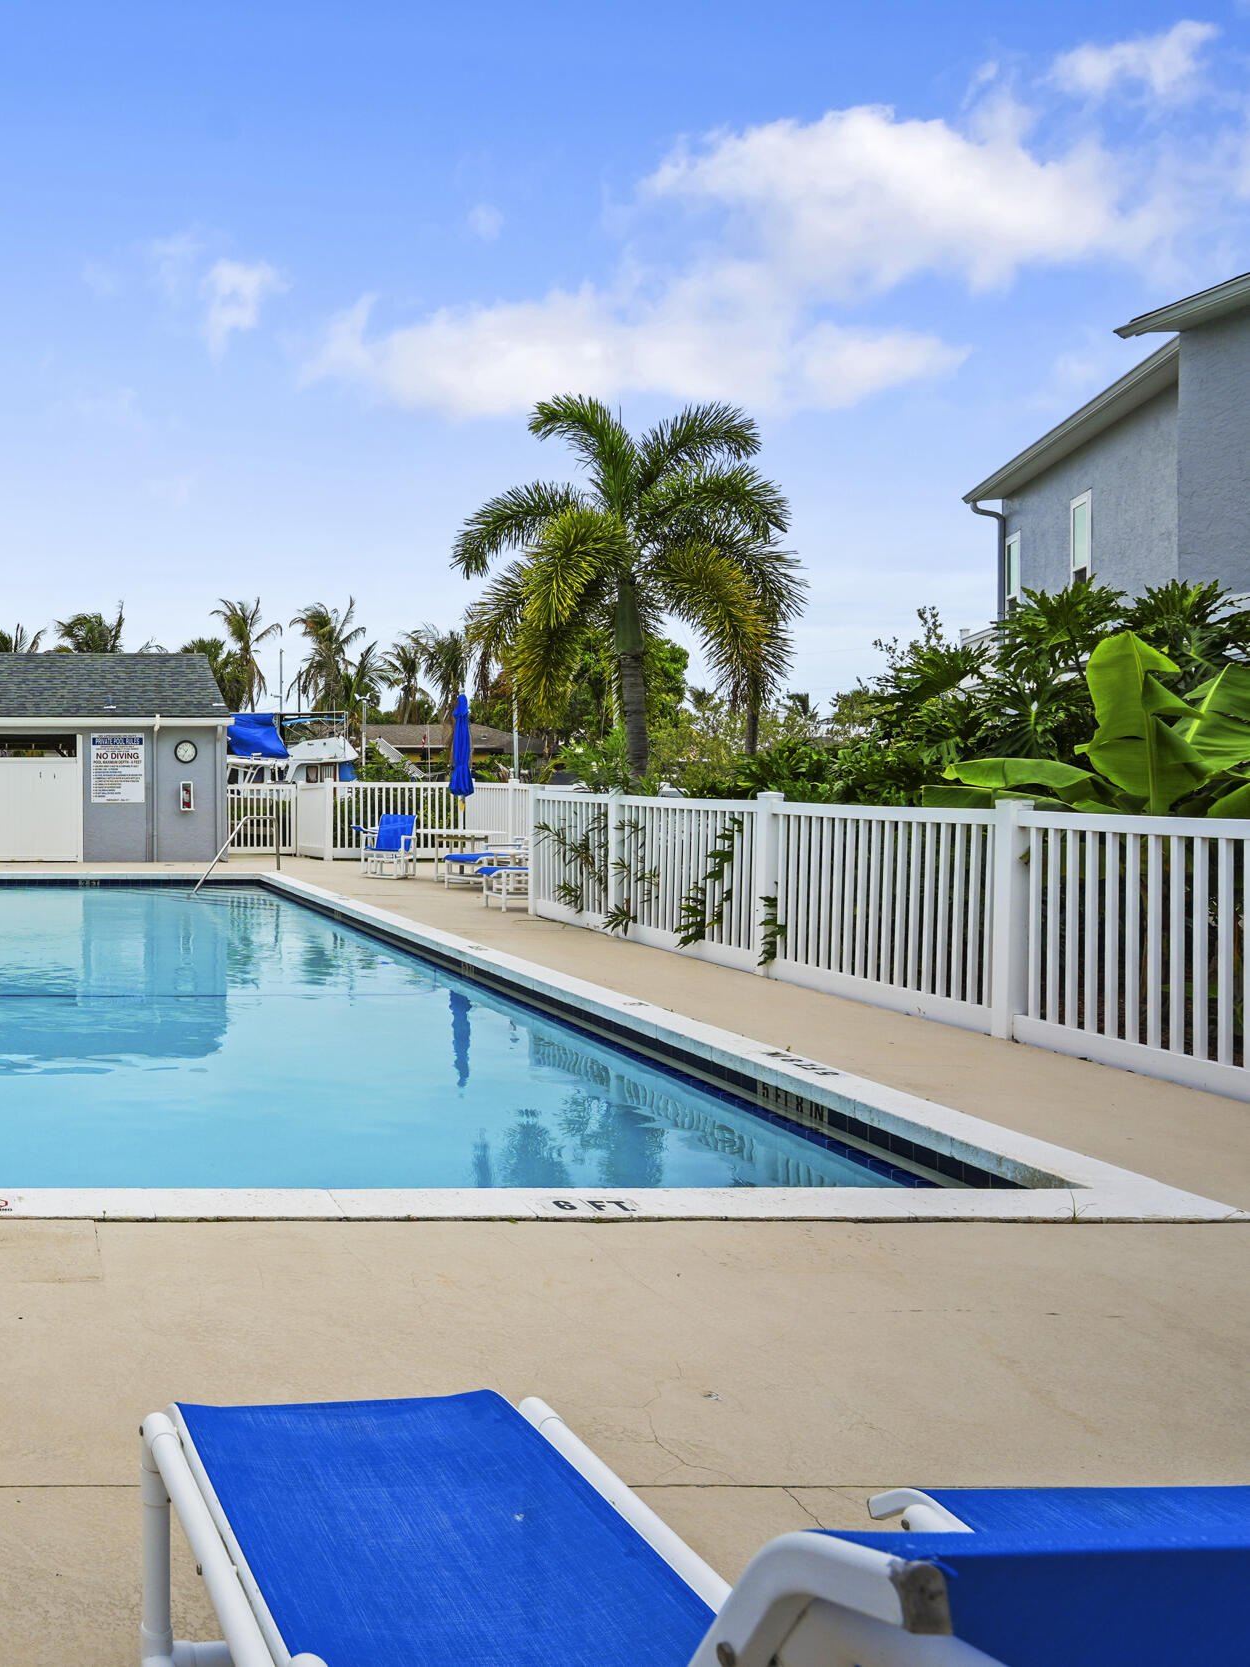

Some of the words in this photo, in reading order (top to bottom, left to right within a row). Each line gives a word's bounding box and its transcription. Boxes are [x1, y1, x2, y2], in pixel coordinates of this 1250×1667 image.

[95, 737, 113, 745] PRIVATE
[113, 737, 125, 745] POOL
[126, 737, 140, 745] RULES
[96, 752, 109, 760] NO
[111, 752, 139, 760] DIVING
[762, 1082, 769, 1099] 5
[552, 1200, 578, 1211] 6
